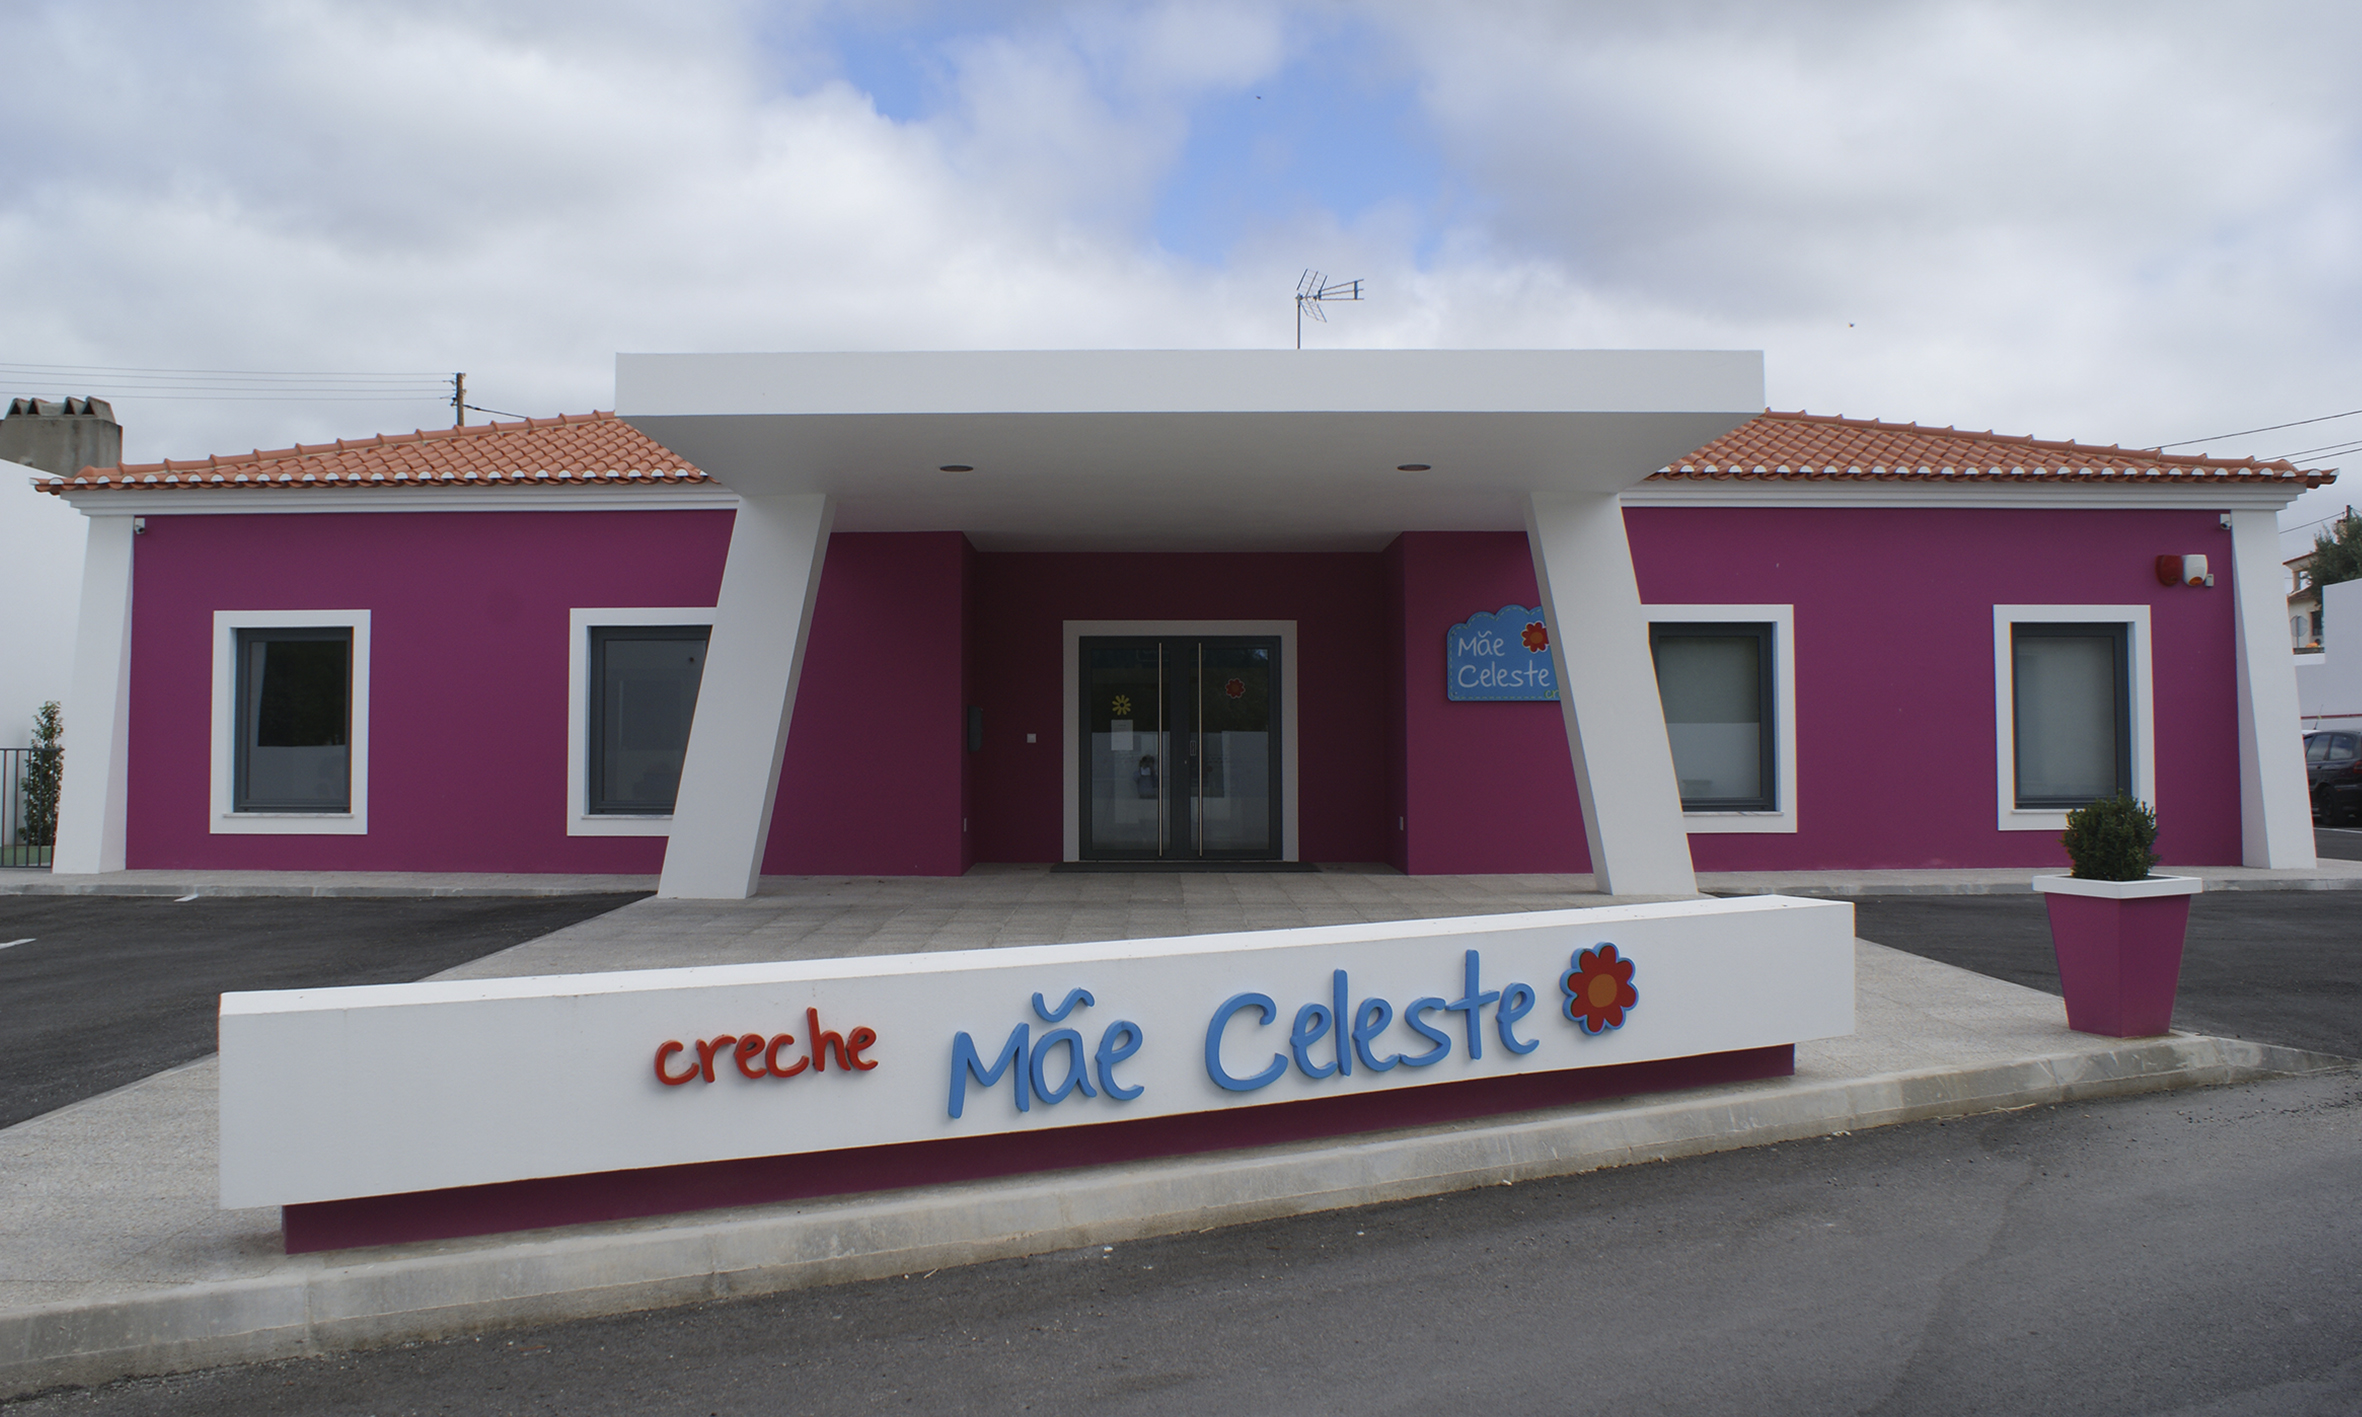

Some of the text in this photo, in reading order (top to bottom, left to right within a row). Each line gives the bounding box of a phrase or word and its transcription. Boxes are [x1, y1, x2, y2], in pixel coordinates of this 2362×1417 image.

[1458, 630, 1505, 657] Mãe
[1457, 660, 1550, 688] Celeste
[655, 949, 1541, 1119] creche Mãe Celeste
